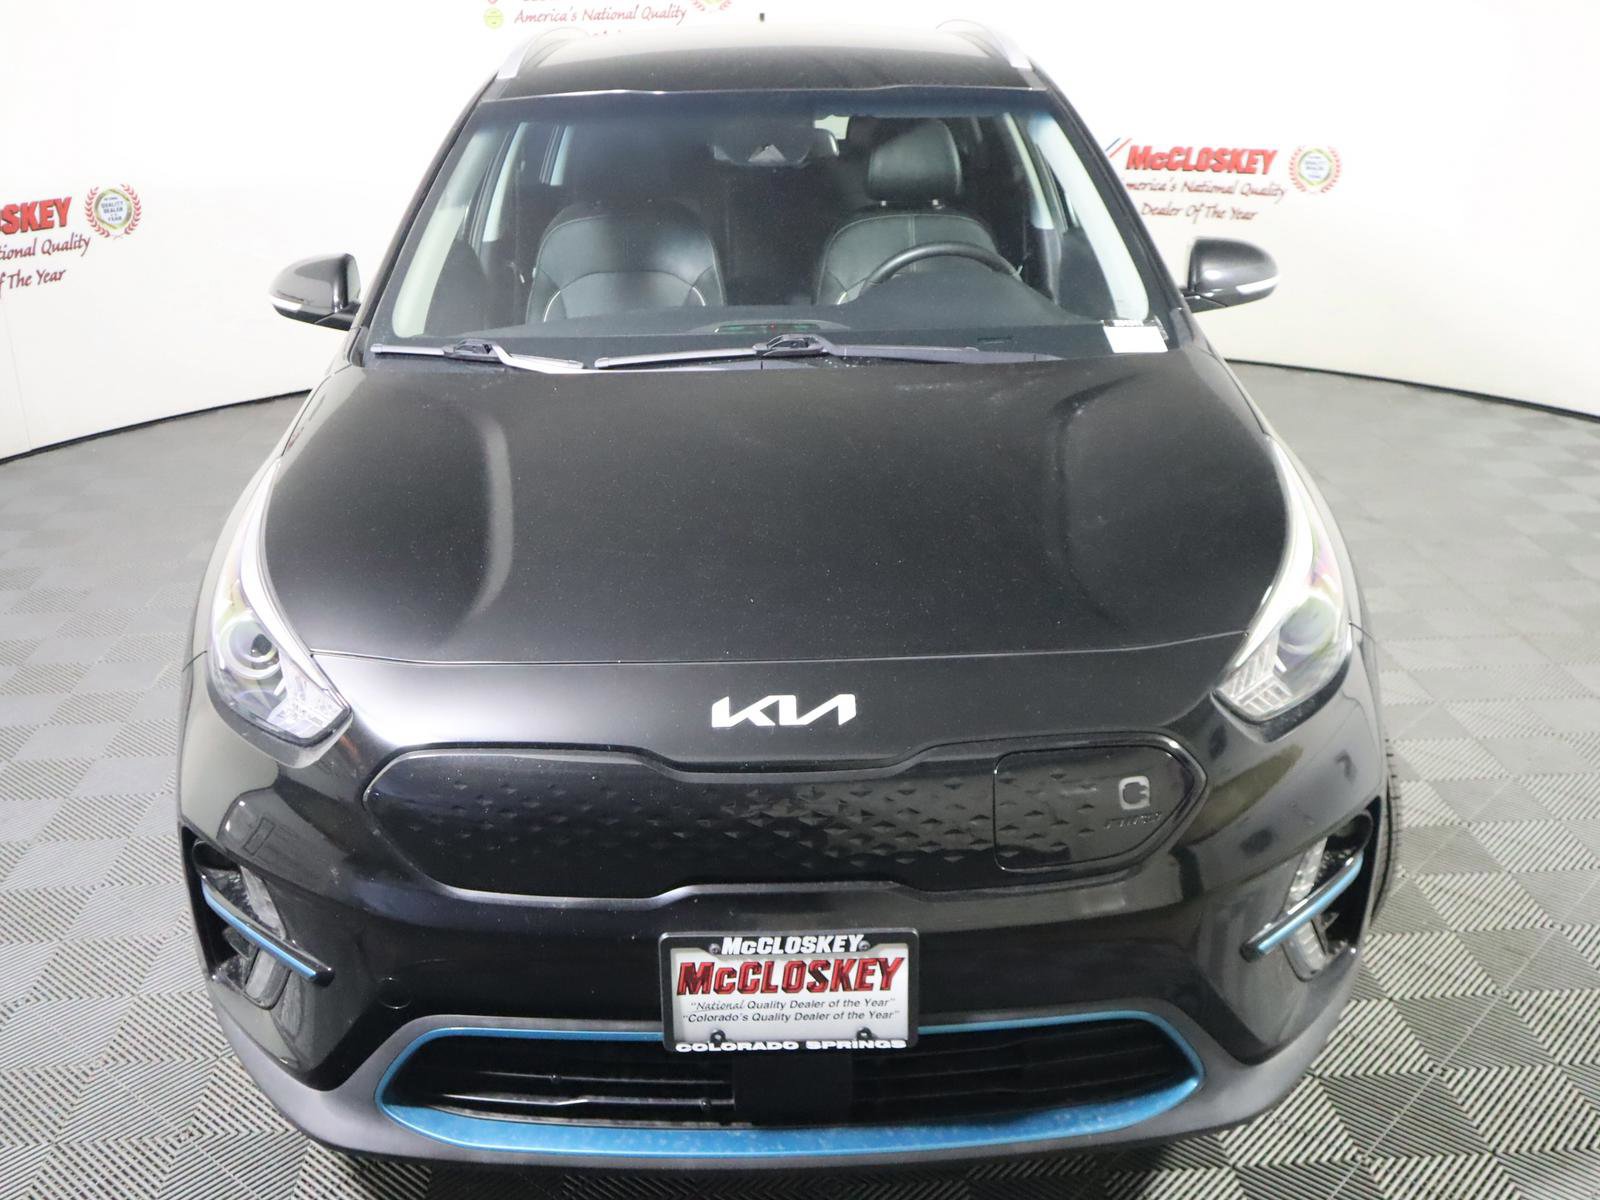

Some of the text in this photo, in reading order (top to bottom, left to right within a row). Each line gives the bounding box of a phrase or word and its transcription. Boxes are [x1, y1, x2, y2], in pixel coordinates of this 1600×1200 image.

[514, 3, 687, 26] America's National Quality
[1126, 145, 1279, 175] McCLOSKEY
[1121, 177, 1285, 204] merica's National Quality
[0, 196, 72, 235] SKEY
[1141, 201, 1183, 216] Dealer
[1229, 206, 1258, 220] Year
[41, 232, 91, 257] Quality
[7, 269, 33, 289] The
[36, 269, 67, 285] Year
[711, 693, 856, 728] KIA
[721, 934, 865, 956] McCLOSKEY
[676, 957, 905, 996] McCLOSKEY
[747, 1000, 787, 1011] Quality
[789, 1000, 825, 1009] Dealer
[828, 999, 840, 1008] of
[843, 999, 861, 1008] the
[751, 1012, 792, 1024] Quality
[794, 1012, 830, 1021] Dealer
[832, 1011, 845, 1020] of
[847, 1011, 866, 1020] the
[675, 1039, 908, 1053] COLORADO SPRINGS
